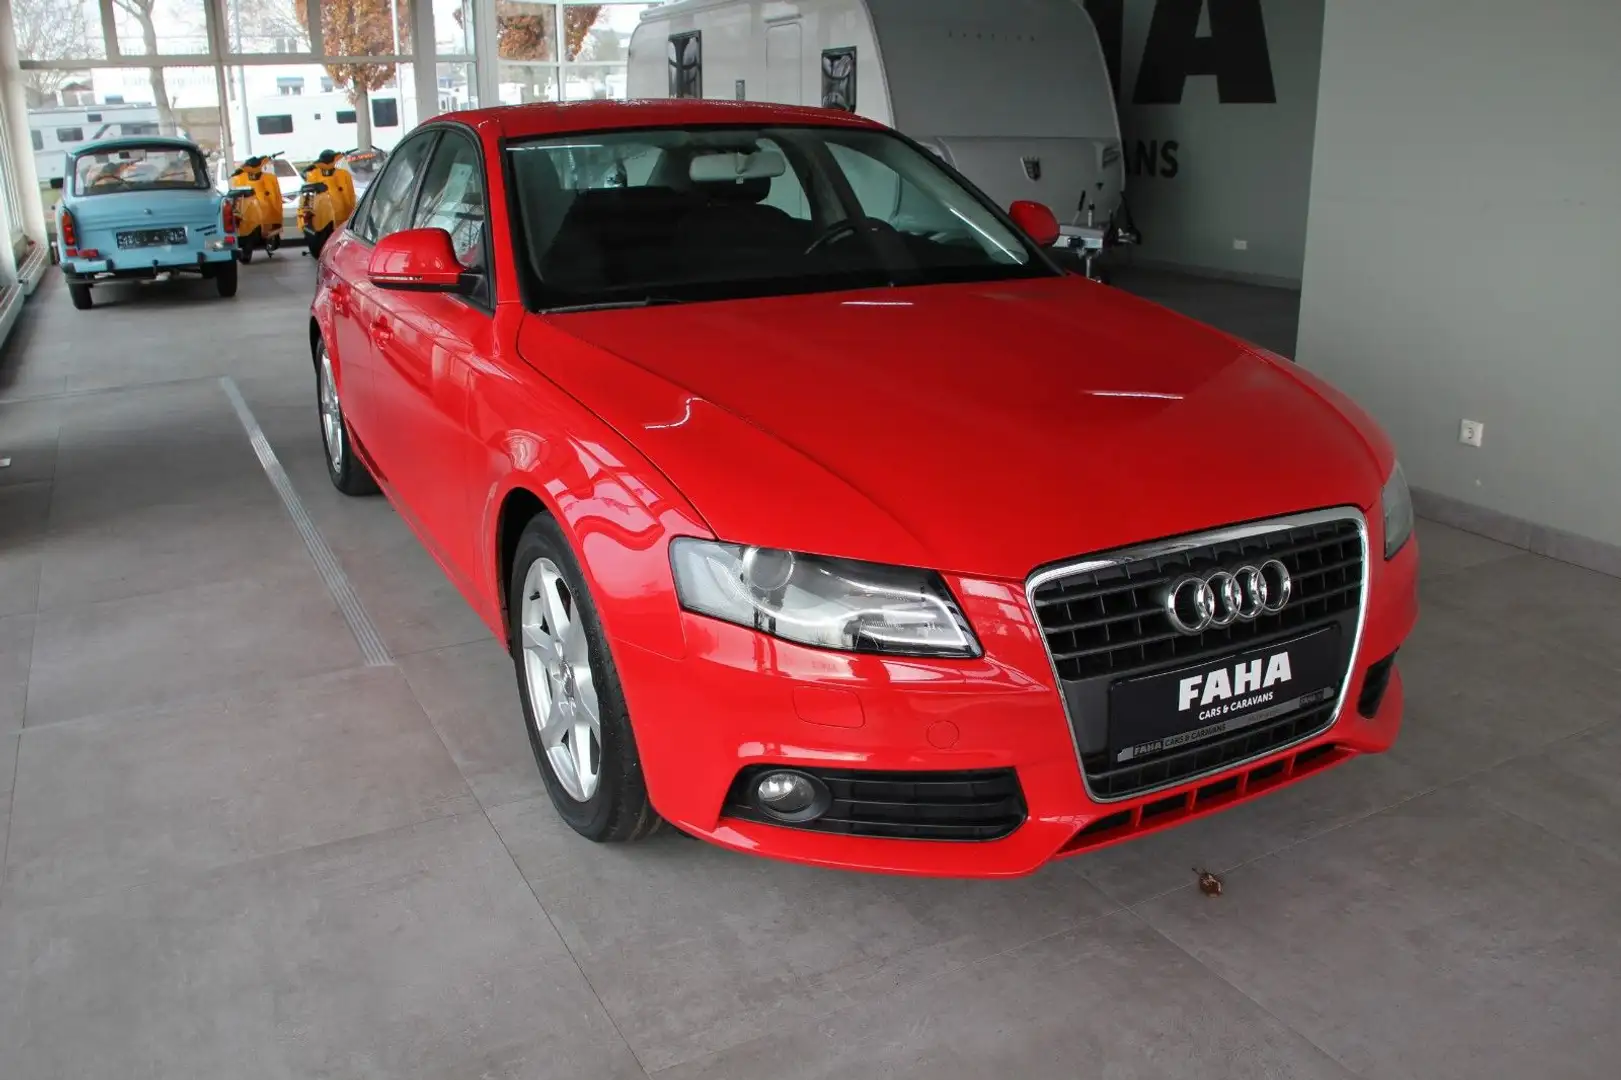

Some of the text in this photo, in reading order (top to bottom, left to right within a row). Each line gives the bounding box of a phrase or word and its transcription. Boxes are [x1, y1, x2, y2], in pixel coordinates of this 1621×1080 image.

[1178, 651, 1292, 711] FAHA
[1199, 691, 1274, 721] CARS & CARAVANS
[1134, 741, 1162, 756] FAHA
